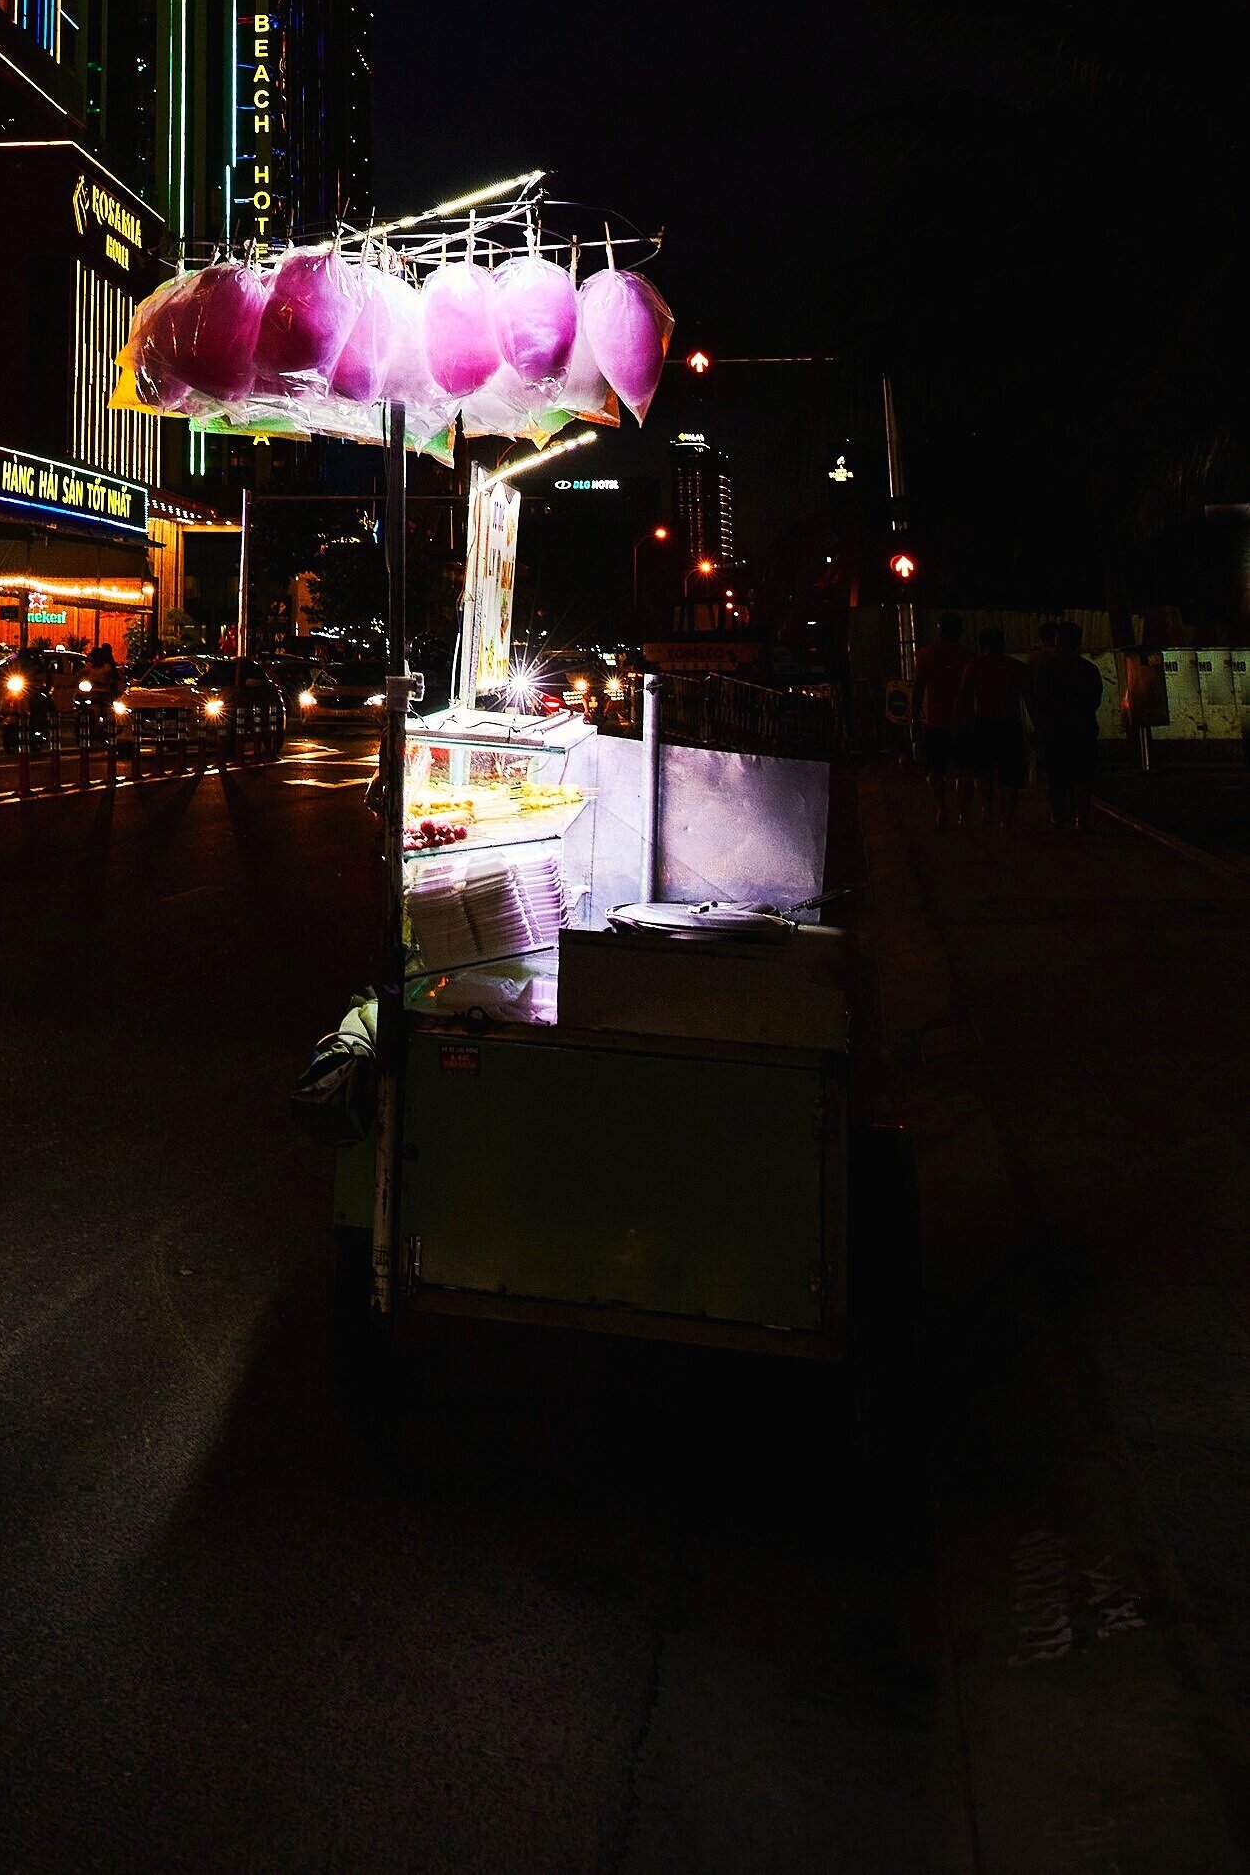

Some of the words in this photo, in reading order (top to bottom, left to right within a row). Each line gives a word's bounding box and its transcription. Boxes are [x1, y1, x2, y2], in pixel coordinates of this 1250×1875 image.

[253, 14, 271, 133] BEACH
[92, 184, 142, 248] ROSAMIA
[253, 165, 270, 261] HOTE
[2, 455, 35, 497] HÀNG
[38, 464, 59, 502] HẢI
[86, 477, 107, 512] TỐT
[107, 485, 132, 518] NHẤT
[591, 479, 619, 489] HOTEL
[27, 611, 66, 624] neken
